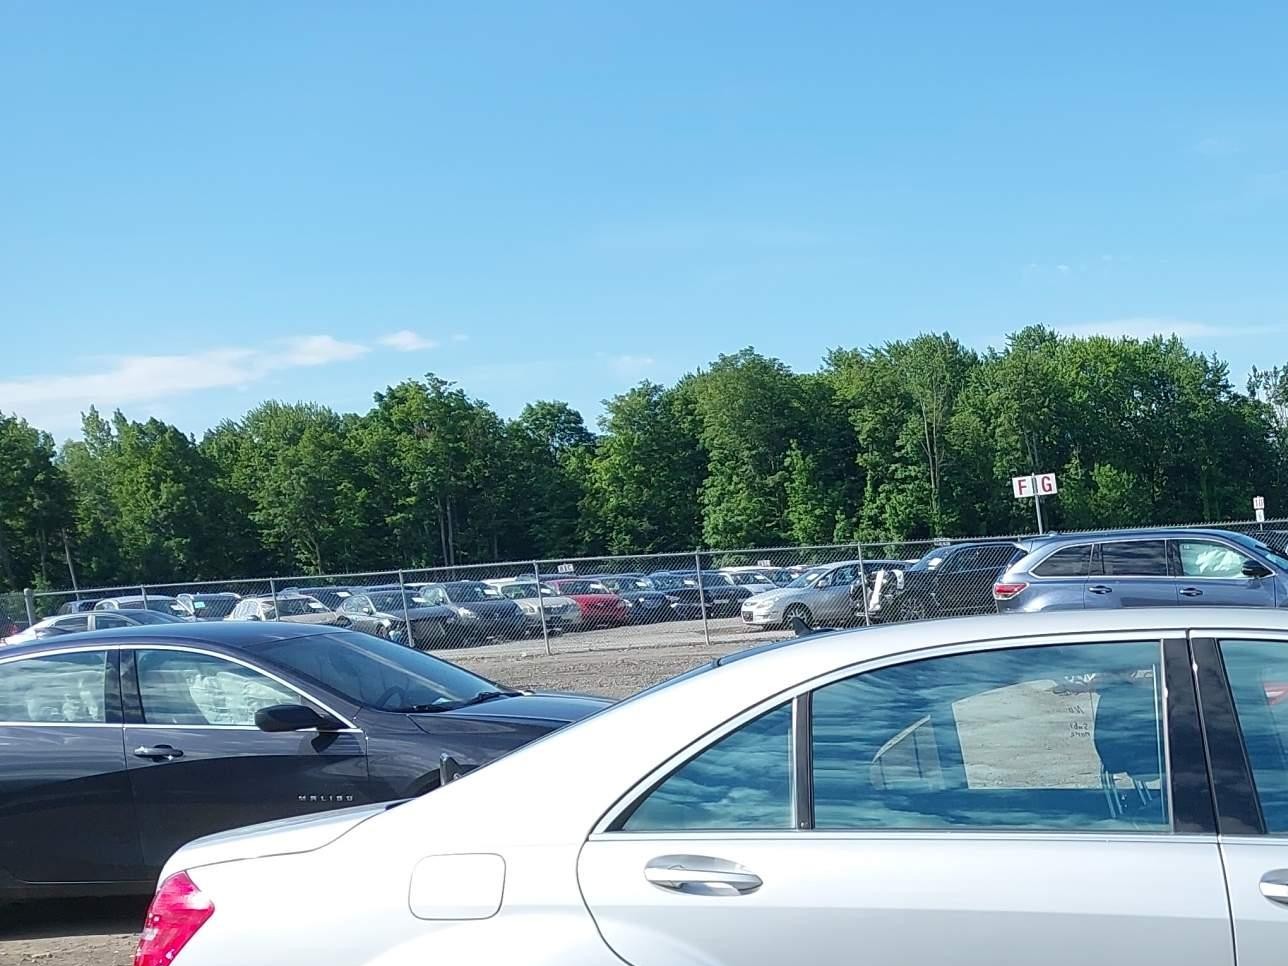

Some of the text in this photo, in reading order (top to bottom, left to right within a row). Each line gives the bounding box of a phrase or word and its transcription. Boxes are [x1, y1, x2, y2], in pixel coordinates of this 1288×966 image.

[1017, 475, 1053, 496] F G
[297, 794, 354, 802] MALIBU
